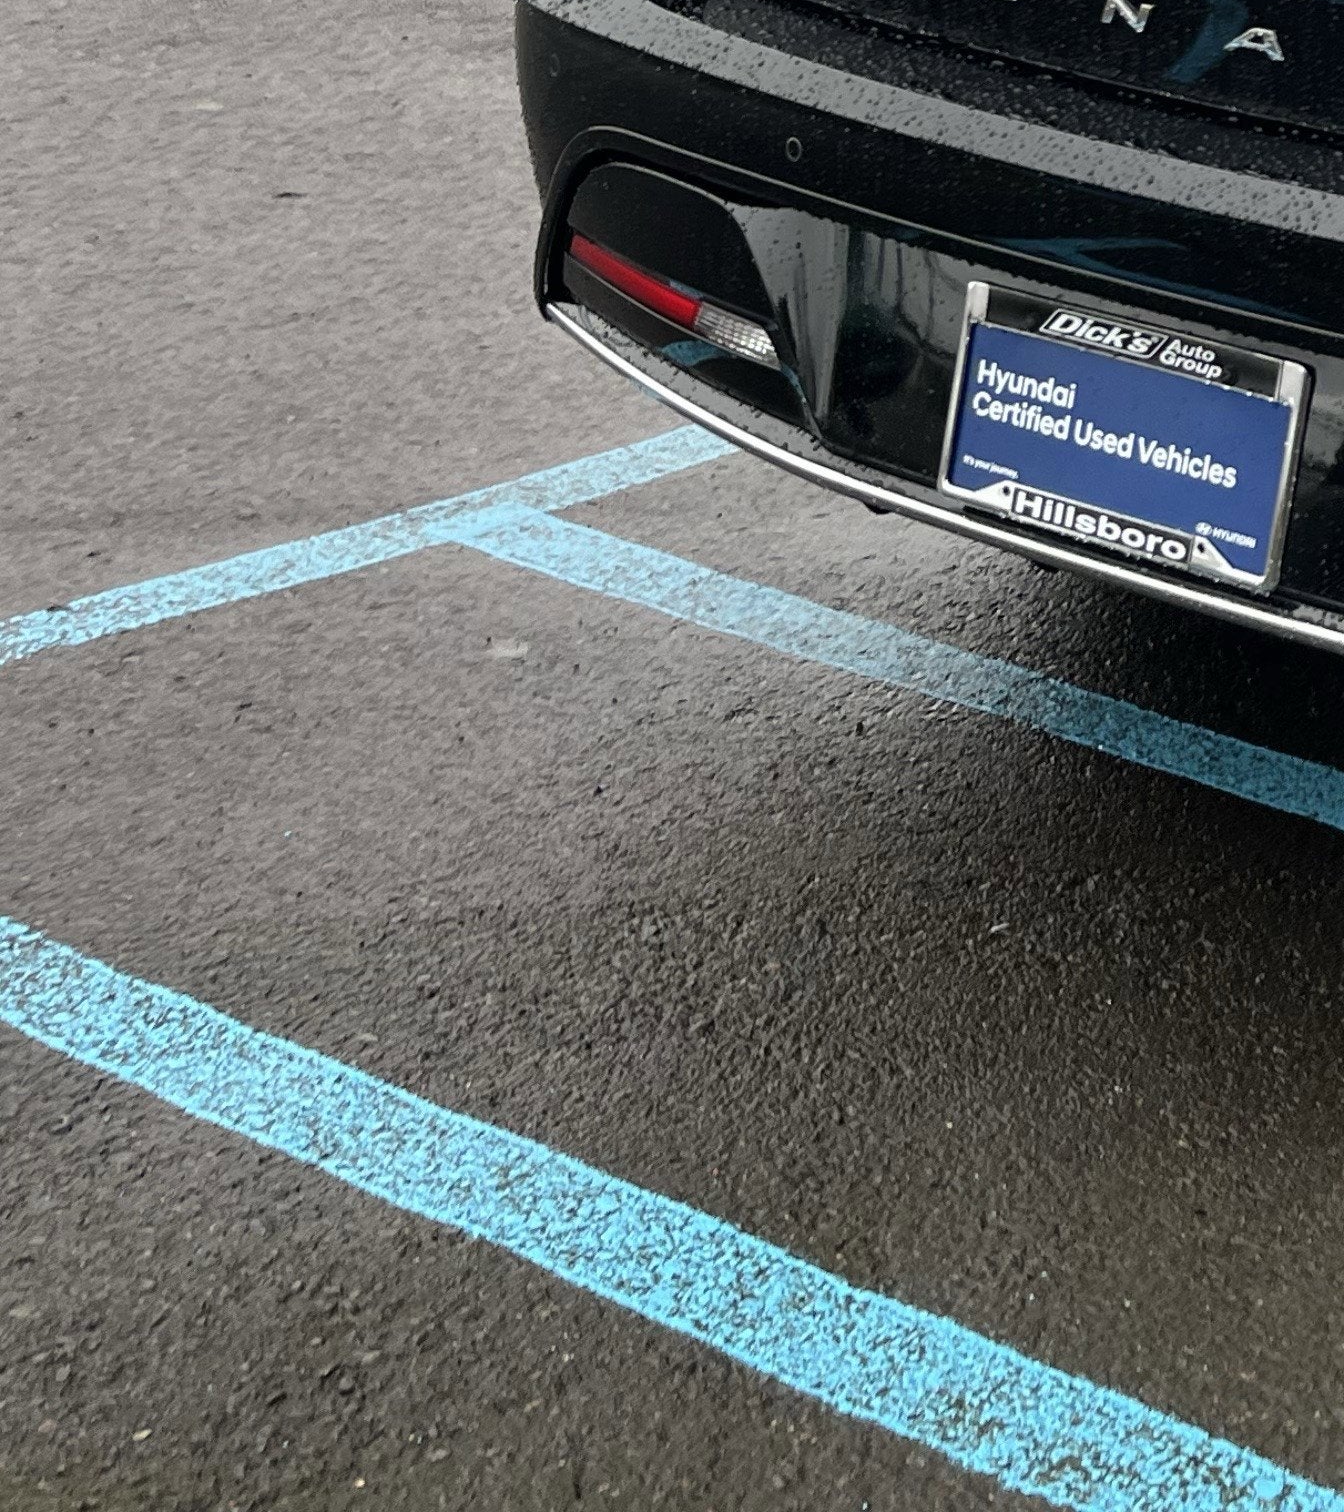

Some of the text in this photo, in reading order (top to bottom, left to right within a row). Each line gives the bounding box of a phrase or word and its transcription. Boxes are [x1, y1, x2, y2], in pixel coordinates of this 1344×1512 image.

[1158, 350, 1223, 379] Group
[1167, 339, 1216, 363] Auto
[977, 359, 1078, 409] Hyundai
[973, 391, 1238, 489] Certified Used Vehicles
[1014, 490, 1187, 561] Hillsboro
